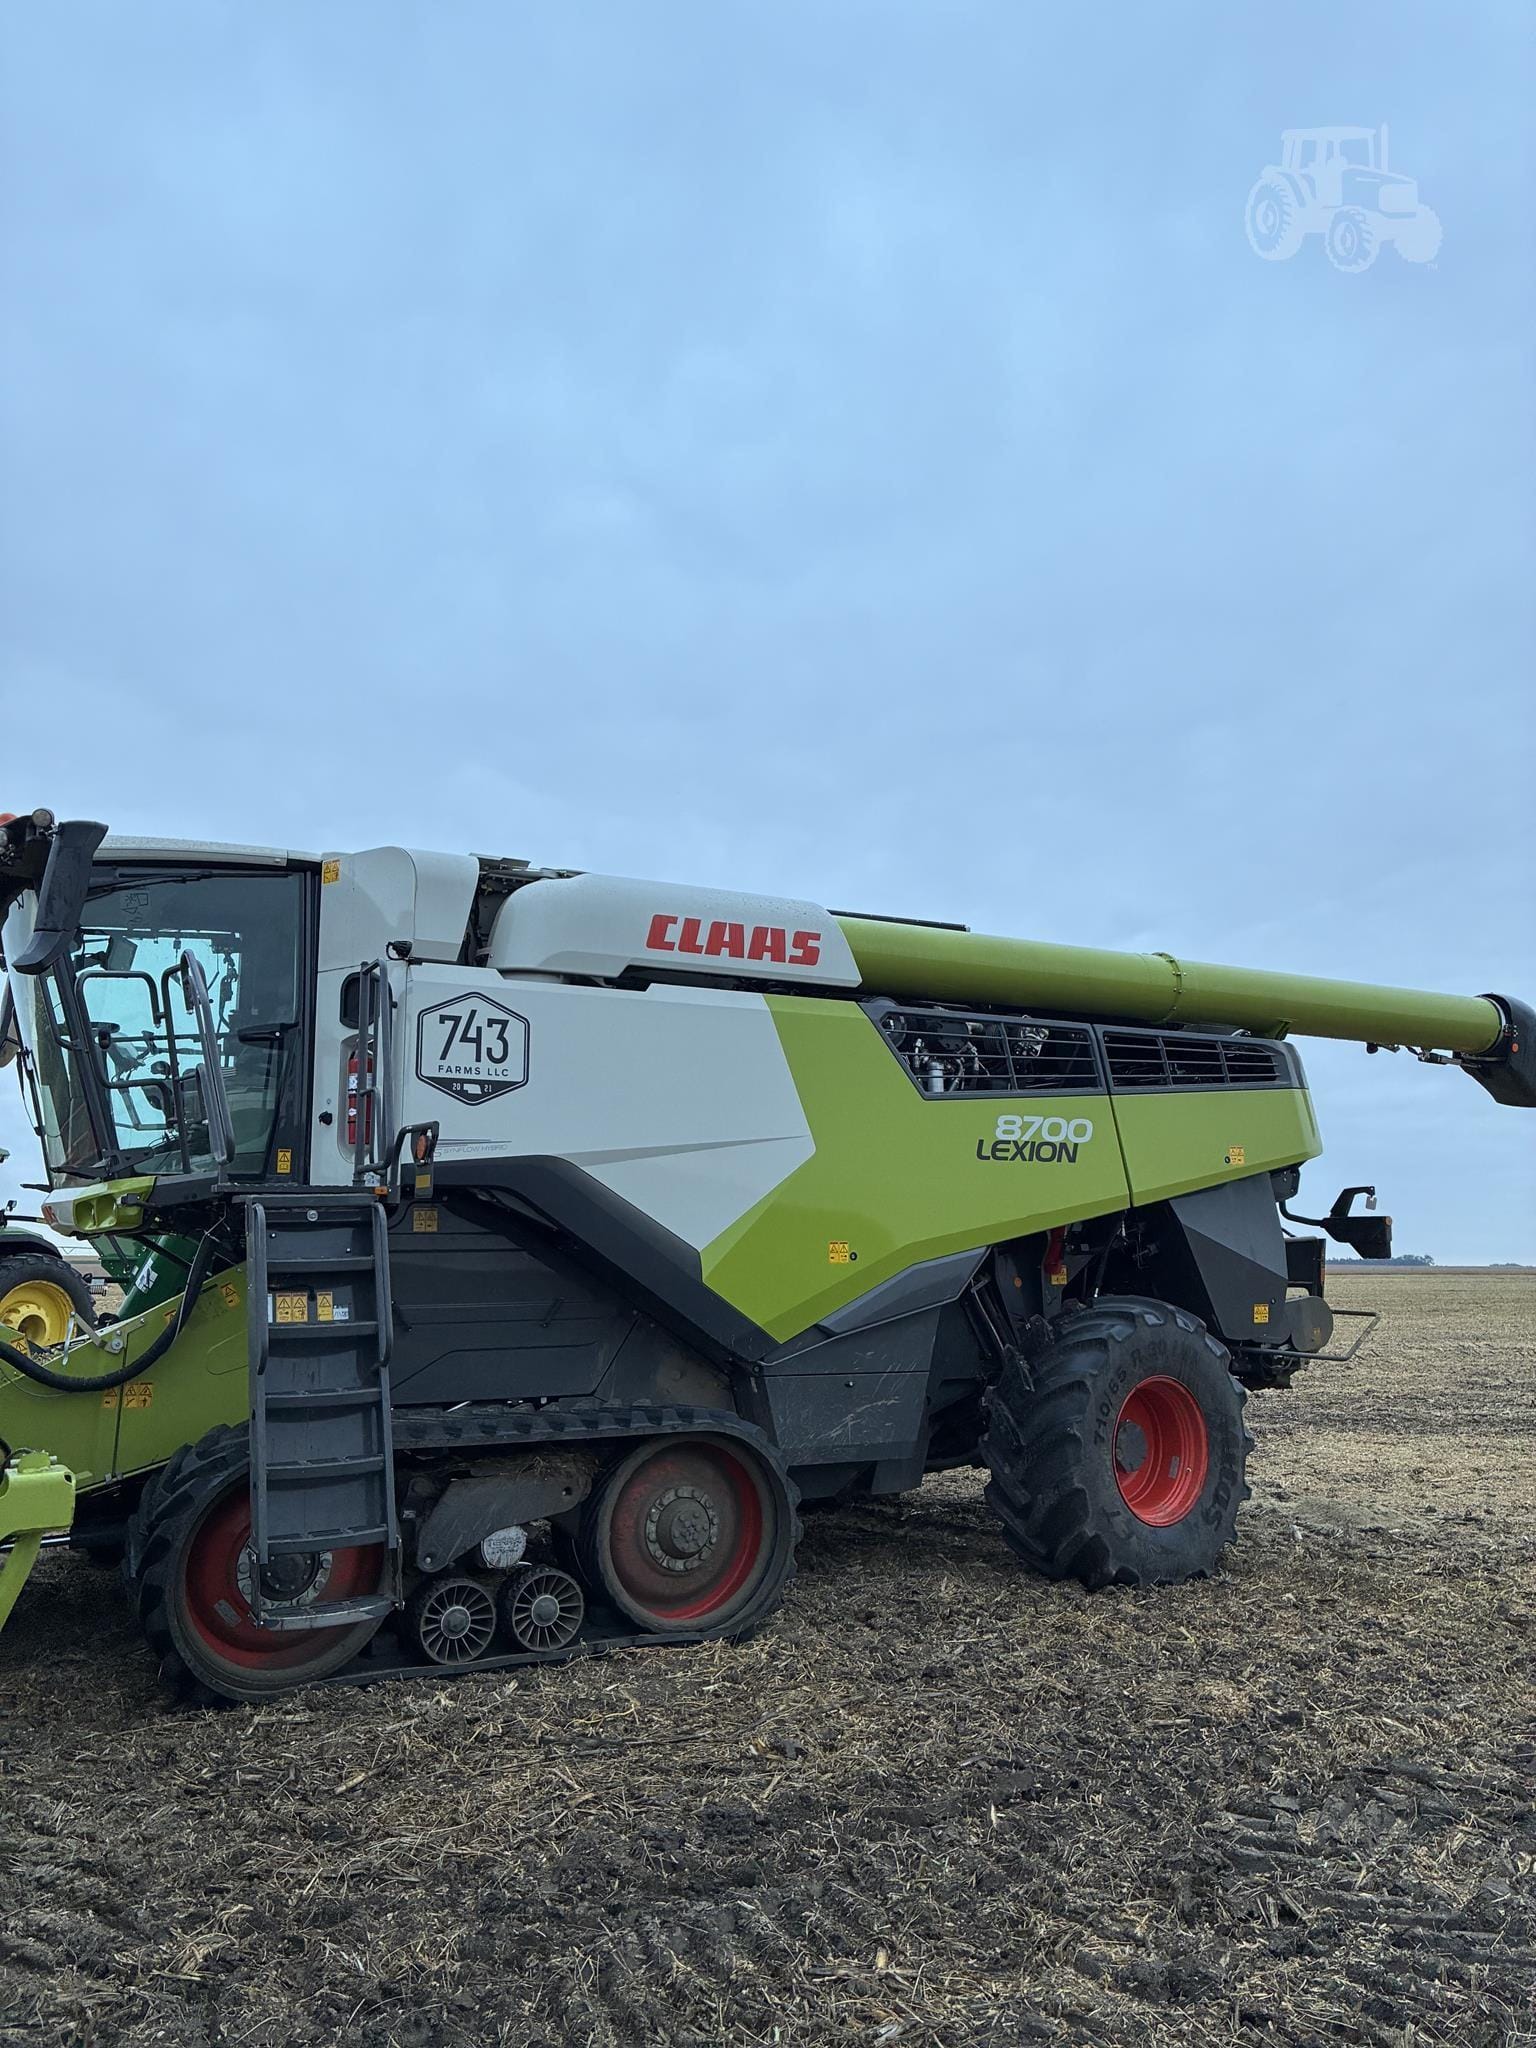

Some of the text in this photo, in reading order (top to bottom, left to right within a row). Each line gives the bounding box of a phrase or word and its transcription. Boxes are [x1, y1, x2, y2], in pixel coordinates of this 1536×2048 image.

[646, 914, 821, 966] CLAAS
[439, 1009, 510, 1064] 743
[438, 1065, 509, 1077] FARMS LLC
[452, 1083, 492, 1092] 20 21
[995, 1114, 1094, 1143] 8700
[976, 1139, 1079, 1163] LEXION
